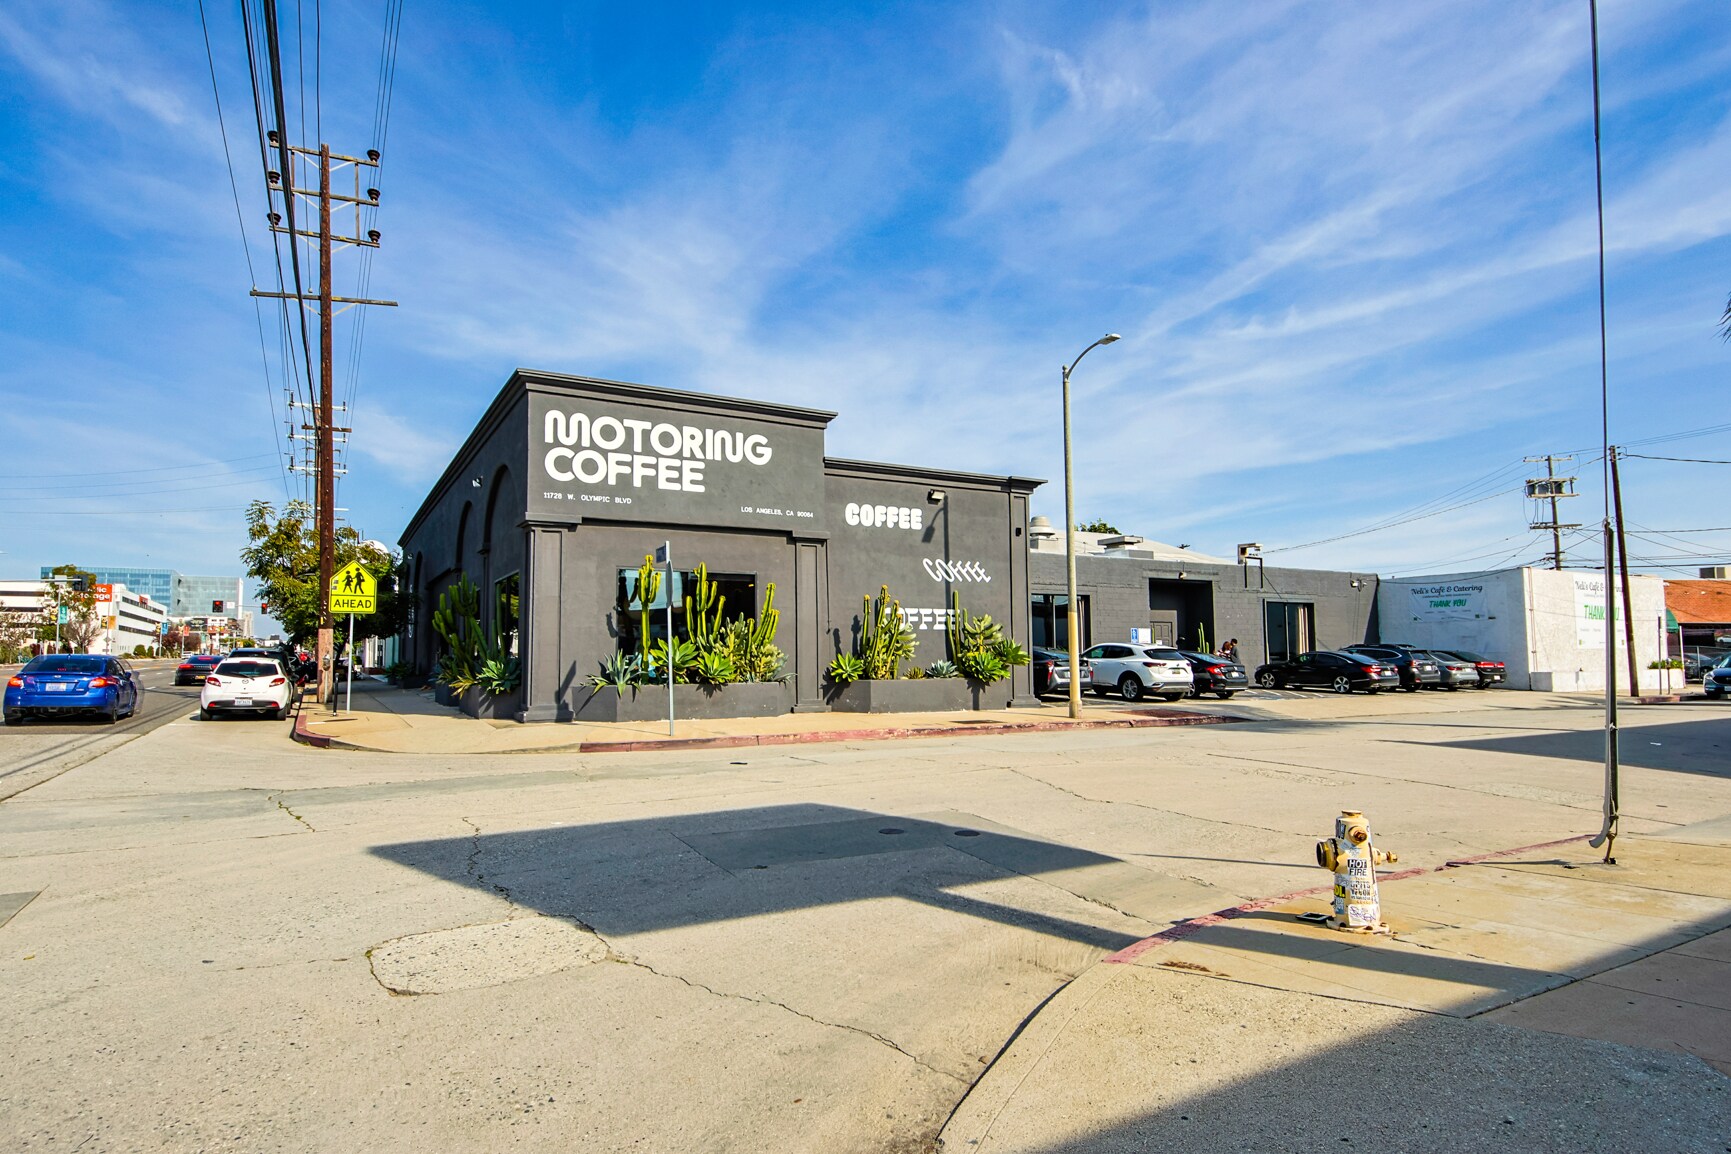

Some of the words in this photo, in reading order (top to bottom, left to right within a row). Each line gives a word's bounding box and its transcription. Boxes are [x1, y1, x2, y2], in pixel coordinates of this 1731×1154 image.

[544, 409, 772, 466] MOTORING
[544, 446, 706, 493] COFFEE
[544, 492, 562, 500] 11728
[581, 494, 610, 503] OLYMPIC
[845, 502, 923, 530] COFFEE
[922, 557, 992, 583] COFFEE
[1446, 585, 1453, 593] &
[1453, 584, 1483, 593] Catering
[333, 599, 372, 609] AHEAD
[1429, 600, 1451, 608] THANK
[1453, 599, 1467, 608] YOU
[1584, 604, 1605, 620] THANK
